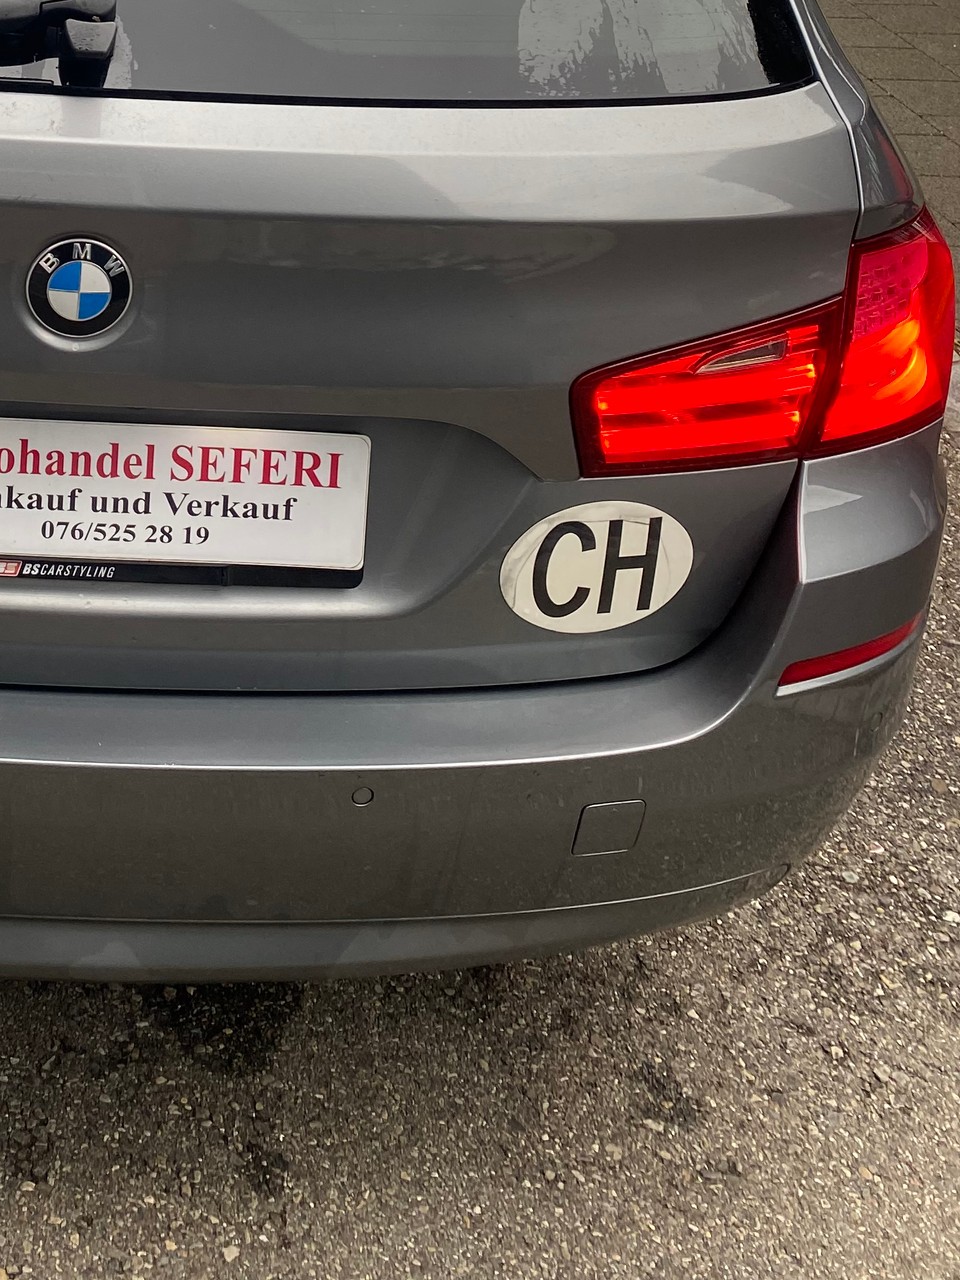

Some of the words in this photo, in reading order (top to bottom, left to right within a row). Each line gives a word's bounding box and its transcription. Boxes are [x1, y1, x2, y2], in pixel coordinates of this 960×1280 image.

[39, 242, 125, 278] BMW
[170, 444, 344, 489] SEFERI
[90, 491, 152, 515] und
[162, 491, 298, 521] Verkauf
[40, 520, 137, 543] 076/525
[144, 524, 173, 544] 28
[182, 526, 210, 545] 19
[532, 516, 663, 618] CH
